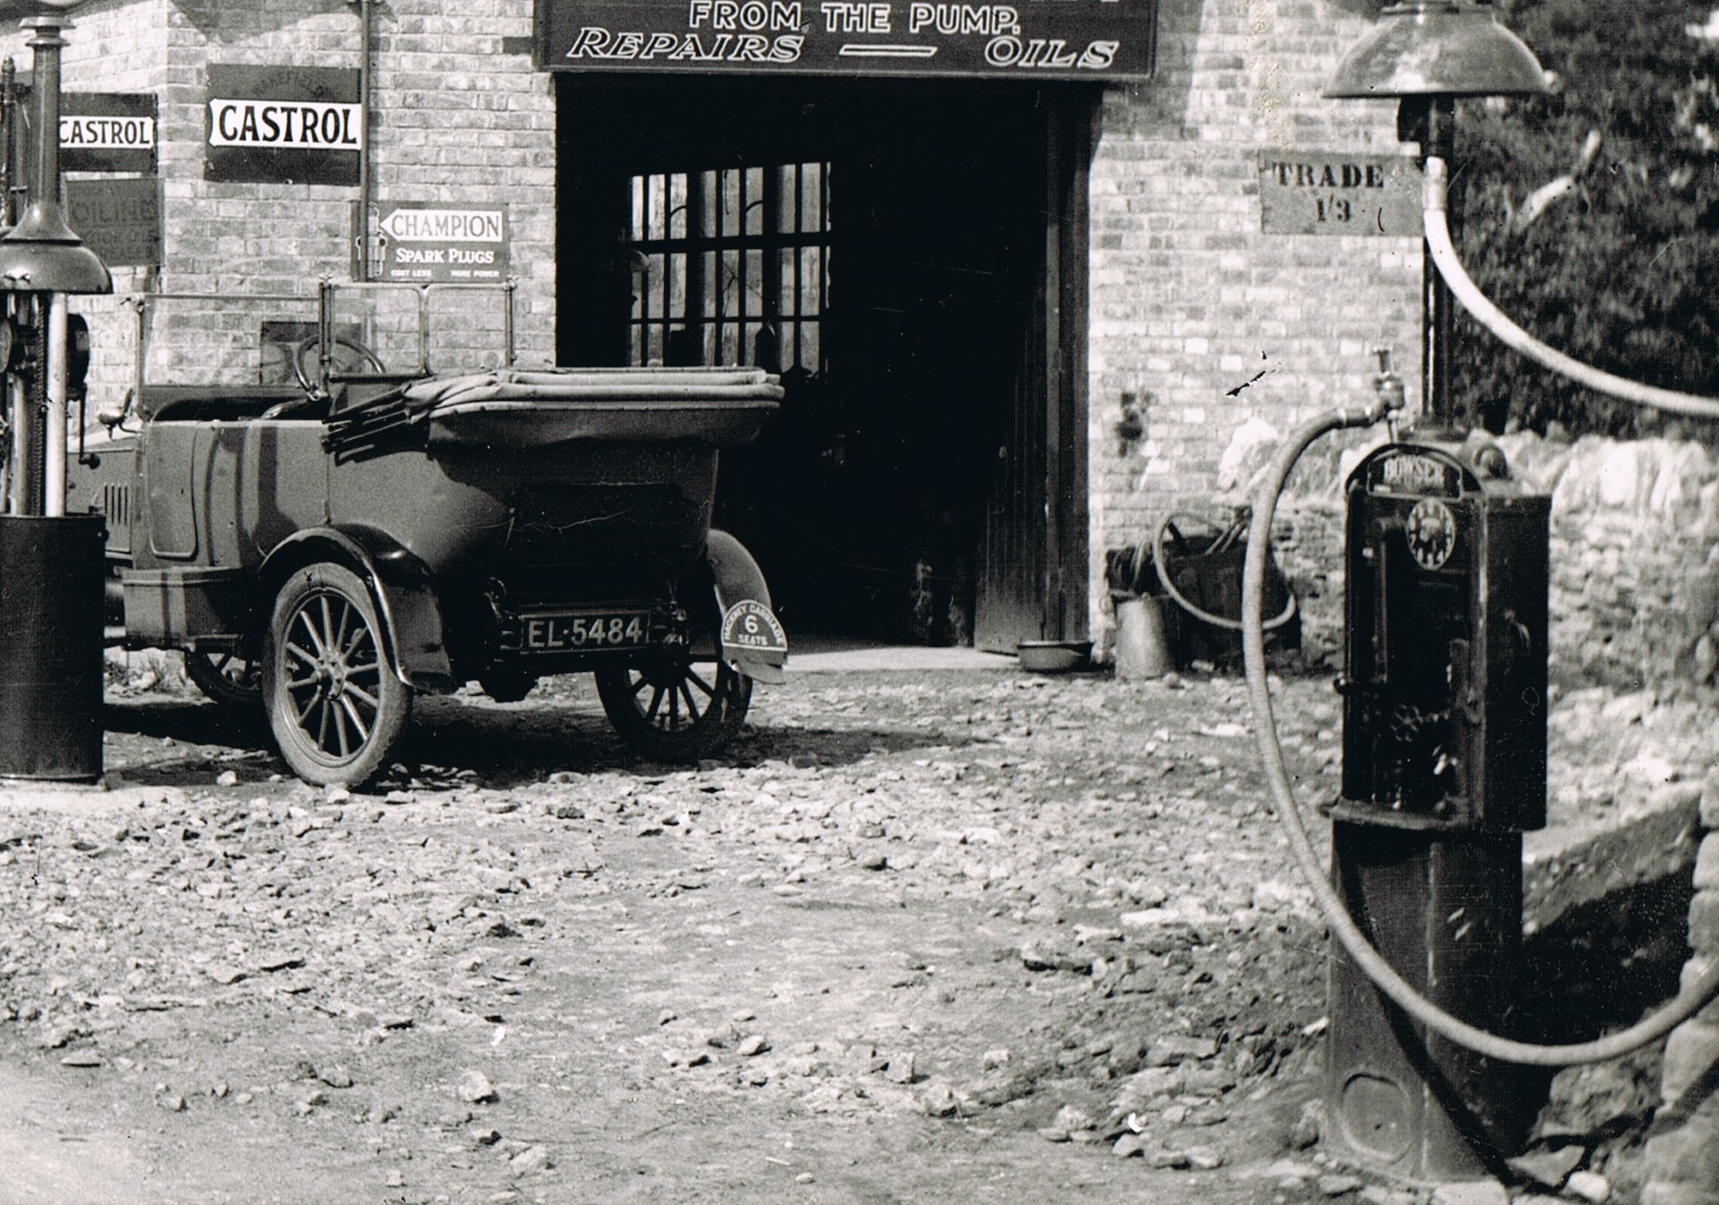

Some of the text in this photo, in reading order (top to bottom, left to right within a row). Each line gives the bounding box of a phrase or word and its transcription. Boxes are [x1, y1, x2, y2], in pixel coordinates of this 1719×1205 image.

[689, 0, 802, 31] FROM
[821, 1, 893, 34] THE
[567, 26, 1121, 69] REPAIRS OILS
[59, 119, 150, 145] CASTROL
[218, 104, 357, 144] CASTROL
[1271, 160, 1382, 188] TRADE
[391, 214, 500, 237] CHAMPION
[395, 247, 495, 265] SPARK PLUGS
[391, 269, 432, 278] COST LESS
[473, 270, 500, 278] POWER
[723, 604, 748, 642] HACKNEY
[744, 613, 759, 635] 6
[737, 633, 769, 646] SEATS
